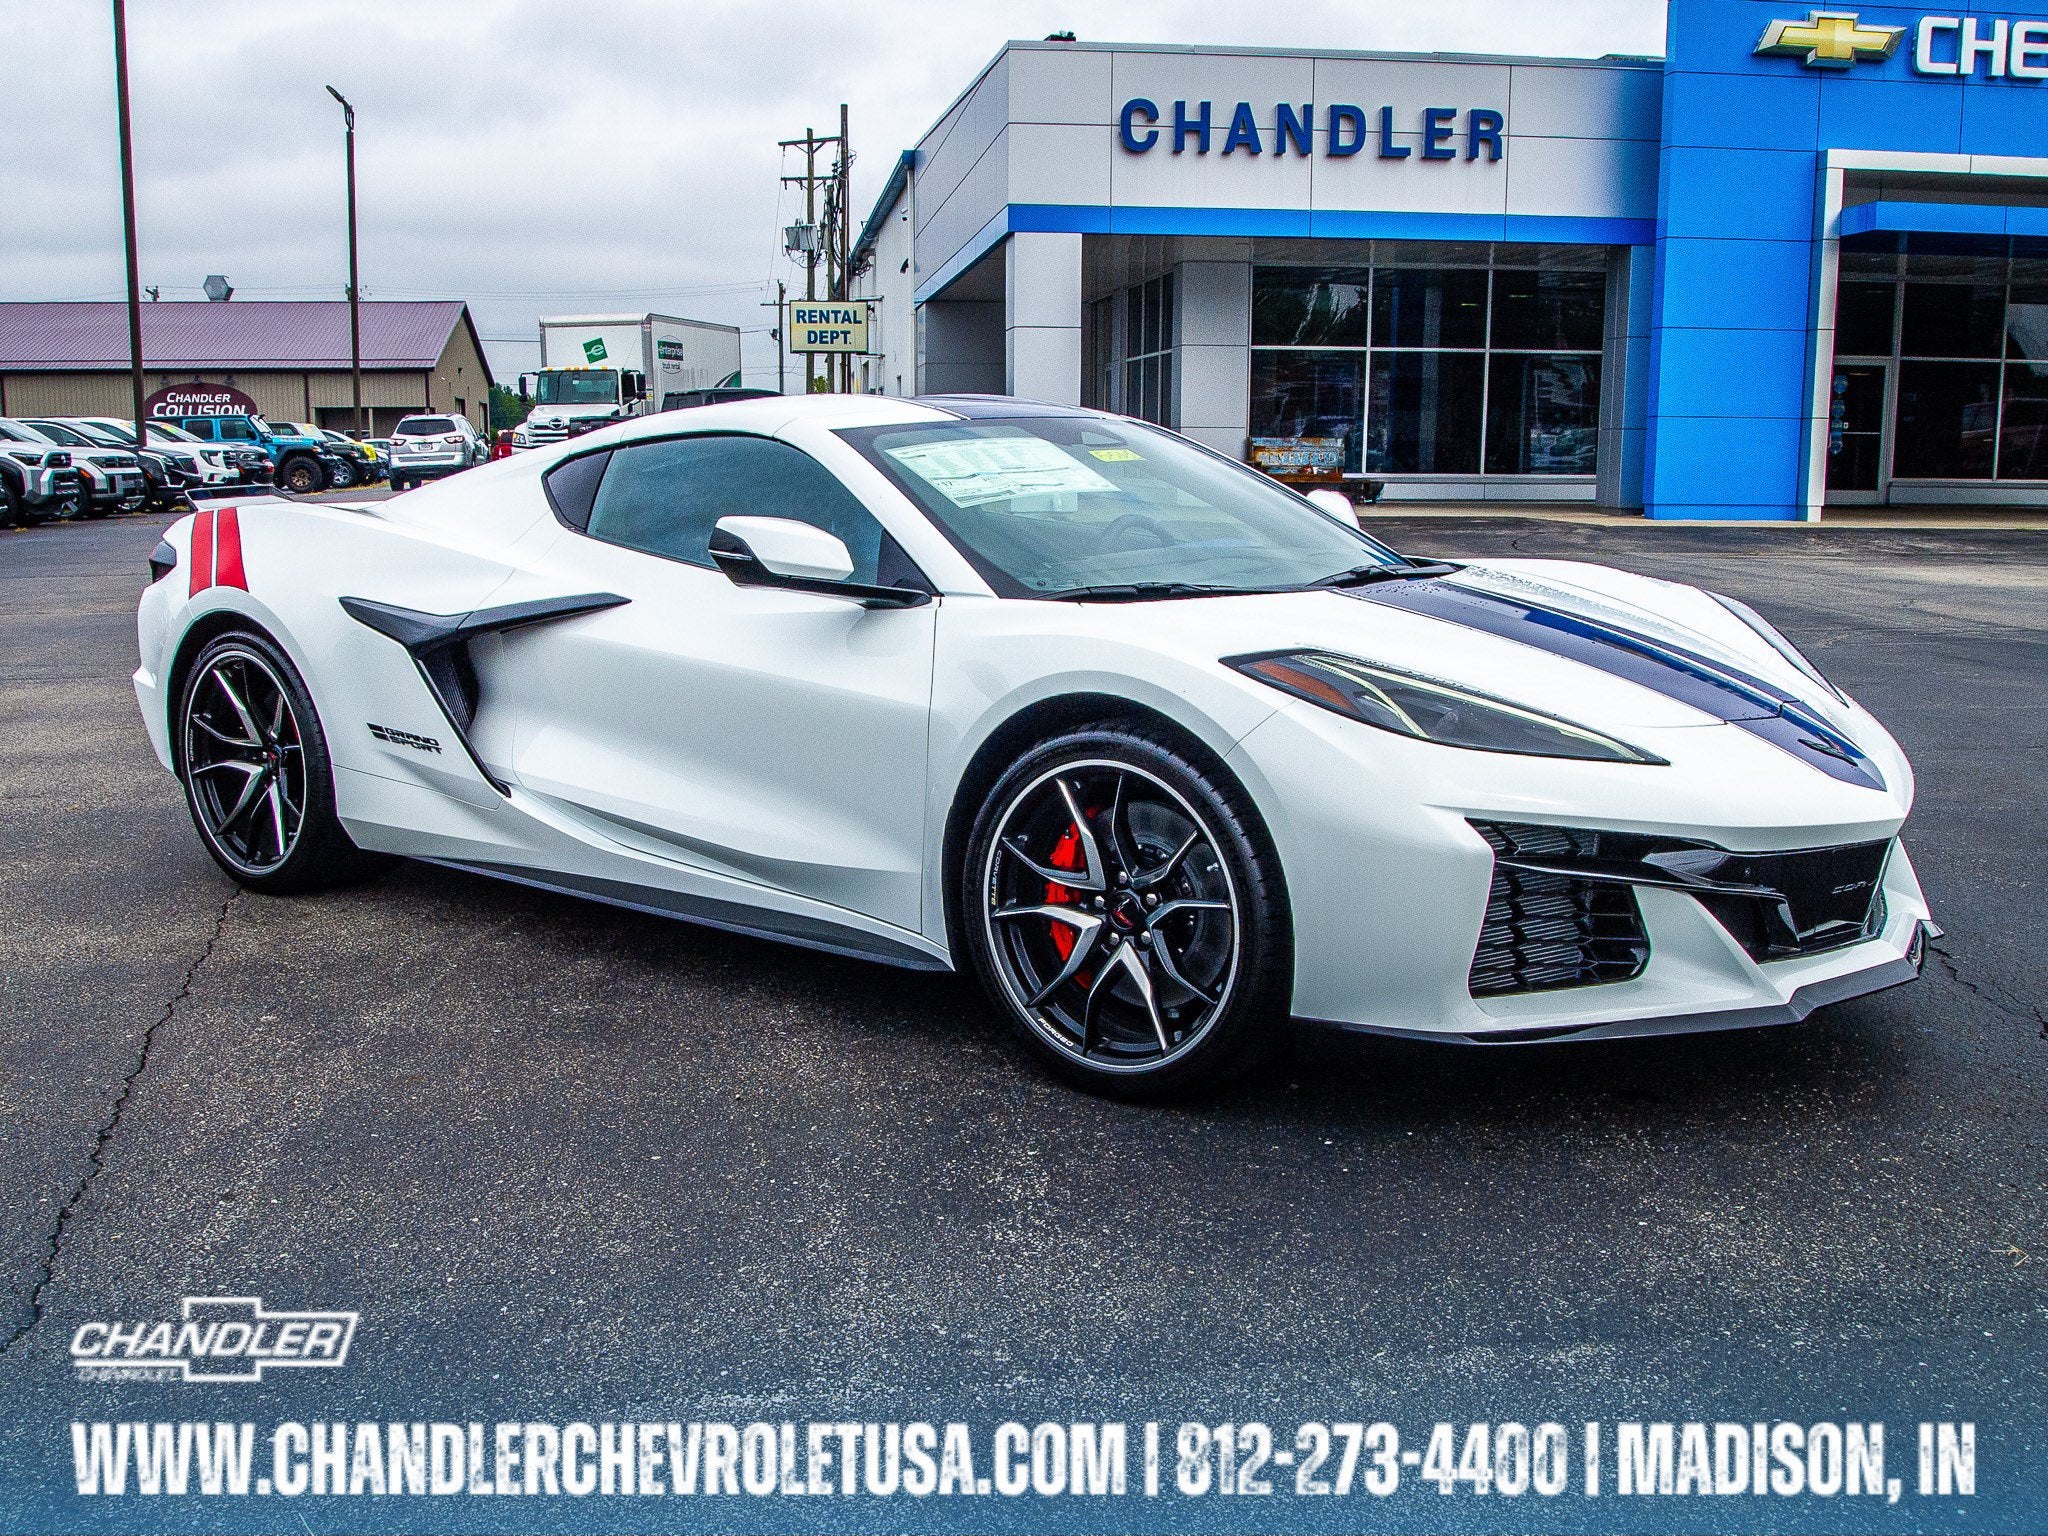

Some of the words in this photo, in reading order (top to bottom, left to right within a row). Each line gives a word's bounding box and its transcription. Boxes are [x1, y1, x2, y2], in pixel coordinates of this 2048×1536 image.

[1914, 16, 2048, 79] CHE
[1120, 98, 1504, 161] CHANDLER
[796, 309, 862, 324] RENTAL
[807, 330, 852, 345] DEPT.
[166, 392, 231, 403] CHANDLER
[153, 403, 246, 417] COLLISION
[384, 727, 440, 746] GRAND
[389, 735, 443, 754] SPORT
[1038, 1017, 1074, 1047] FORGED
